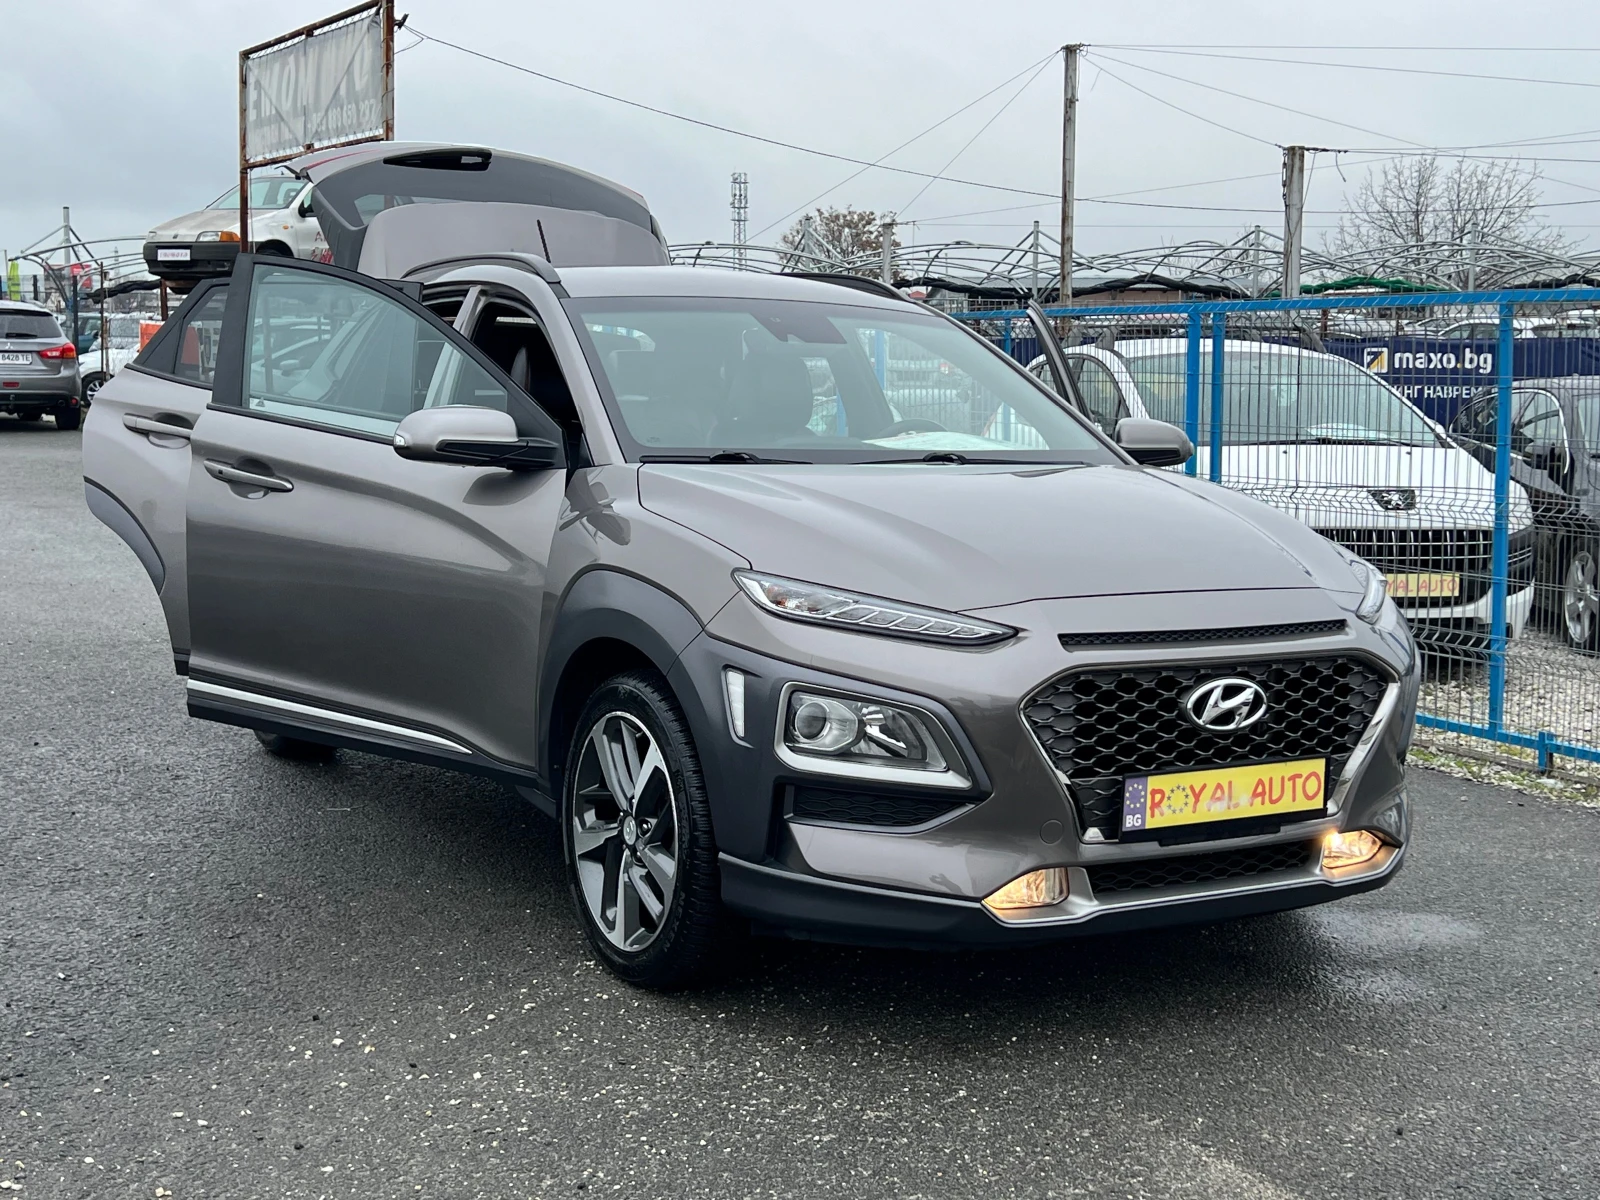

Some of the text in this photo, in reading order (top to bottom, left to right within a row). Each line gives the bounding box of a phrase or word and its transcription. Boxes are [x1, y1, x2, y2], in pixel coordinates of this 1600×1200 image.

[1394, 348, 1493, 373] maxo.bg
[1391, 386, 1498, 399] ИНГ НАВРЕМ
[1418, 579, 1458, 593] AUTO
[1149, 771, 1322, 819] ROYAL AUTO
[1125, 813, 1142, 828] BG
